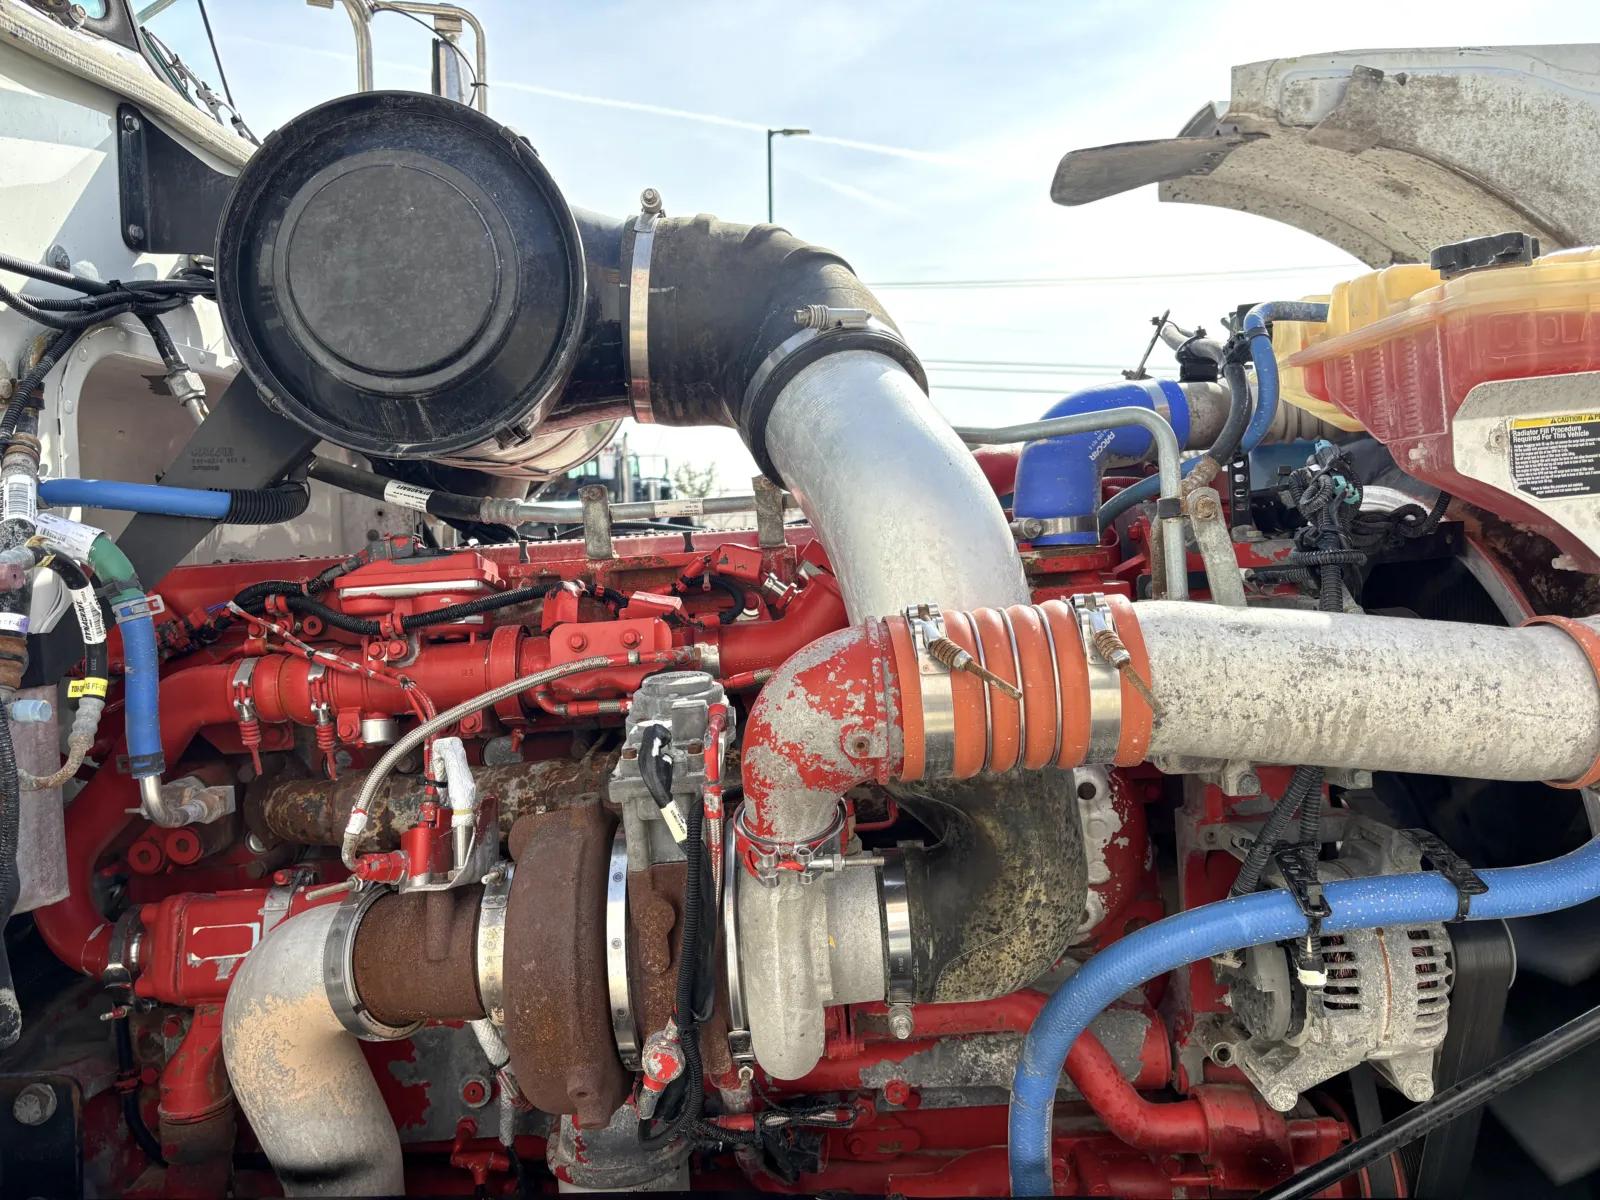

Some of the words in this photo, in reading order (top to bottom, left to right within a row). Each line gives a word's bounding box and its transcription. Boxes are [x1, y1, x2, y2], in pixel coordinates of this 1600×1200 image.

[1557, 415, 1582, 423] CAUTION
[1512, 429, 1539, 437] Radiator
[1540, 427, 1550, 435] Fill
[1551, 425, 1582, 433] Procedure
[1513, 434, 1540, 443] Required
[1568, 429, 1590, 438] Vehicle
[1088, 431, 1115, 461] PACCAR
[75, 600, 92, 641] DYNACRAFT
